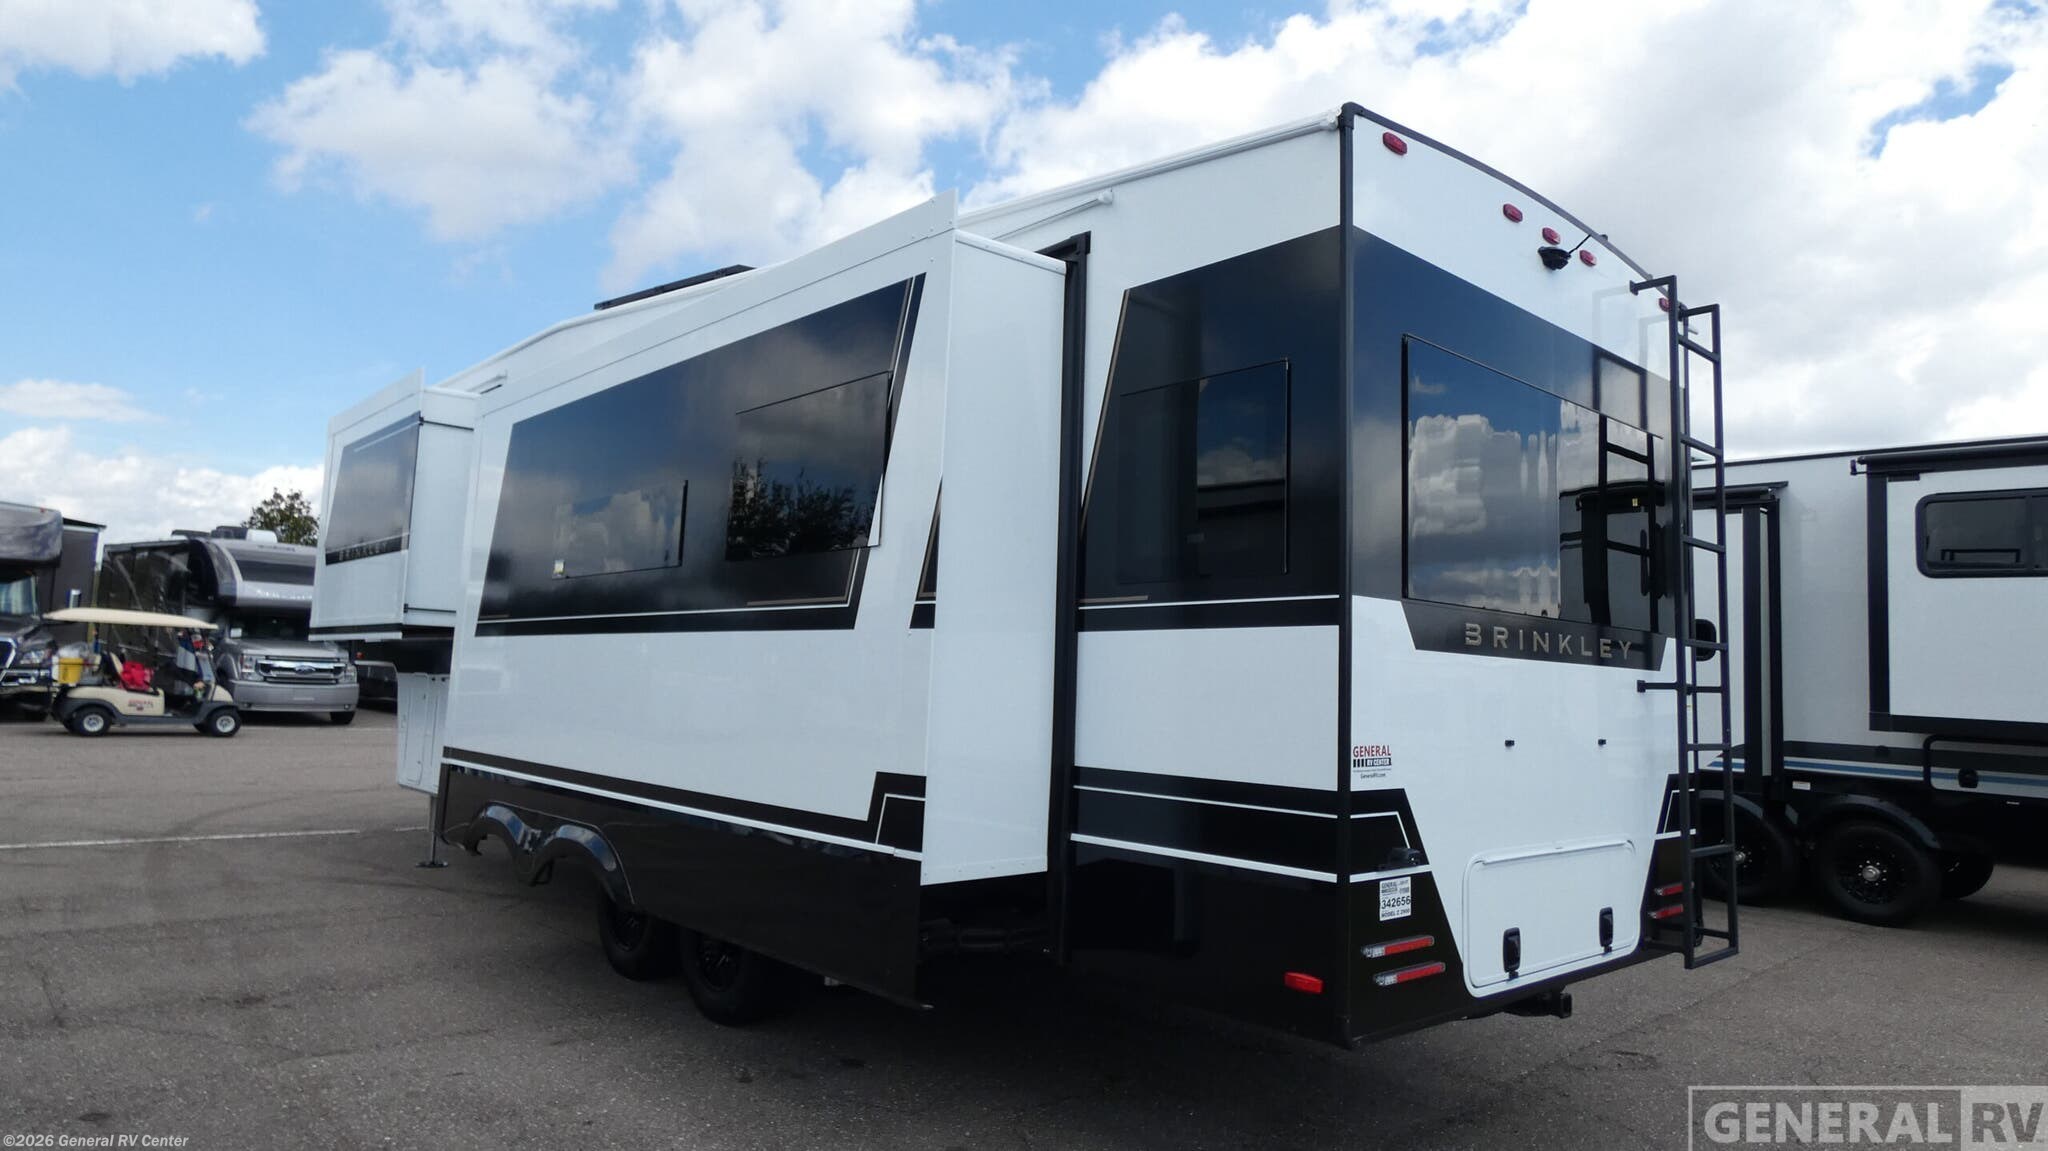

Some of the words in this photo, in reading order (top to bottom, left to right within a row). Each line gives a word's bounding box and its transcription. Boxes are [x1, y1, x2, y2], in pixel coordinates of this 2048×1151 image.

[1465, 622, 1632, 660] BRINKLEY
[1353, 745, 1391, 758] GENERAL
[1381, 895, 1411, 909] 342656
